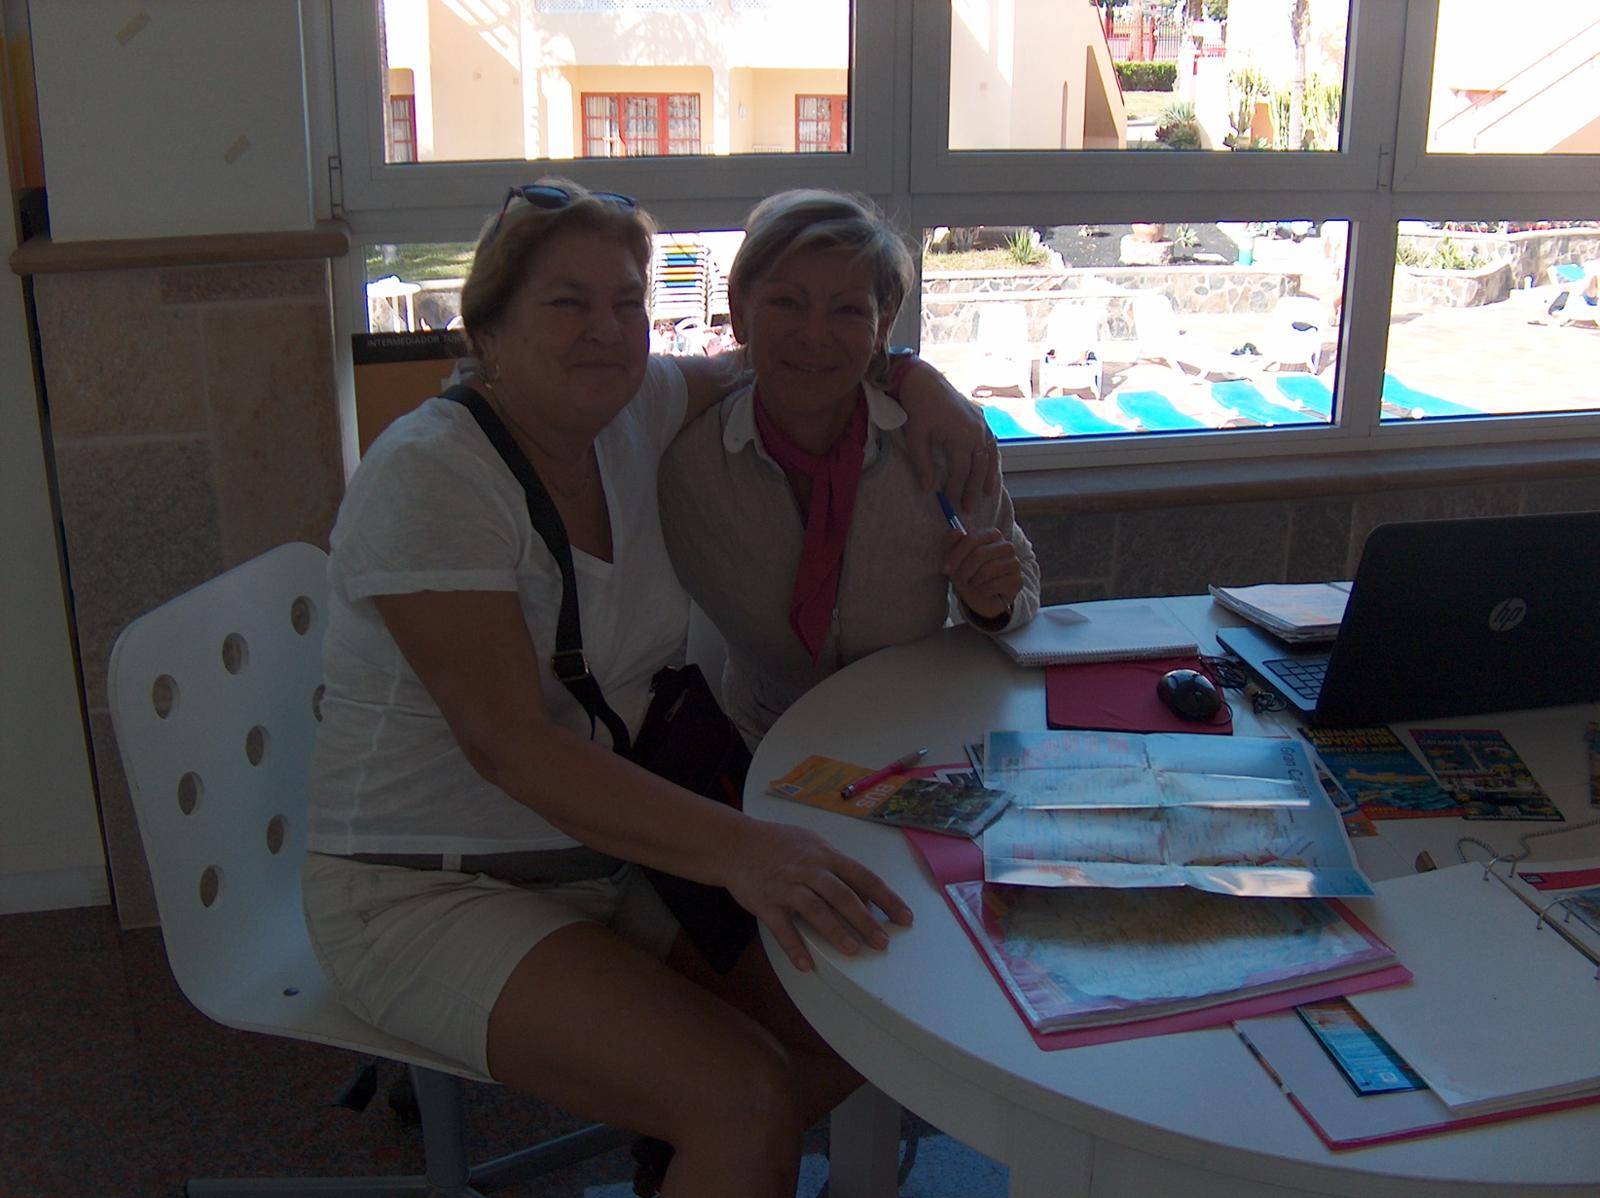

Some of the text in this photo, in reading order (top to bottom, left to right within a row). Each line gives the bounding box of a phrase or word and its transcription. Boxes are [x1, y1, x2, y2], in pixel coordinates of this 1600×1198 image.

[367, 335, 439, 348] INTERMEDIADOR
[1492, 597, 1523, 632] hp
[1280, 746, 1296, 767] Gran
[856, 783, 896, 809] BUS
